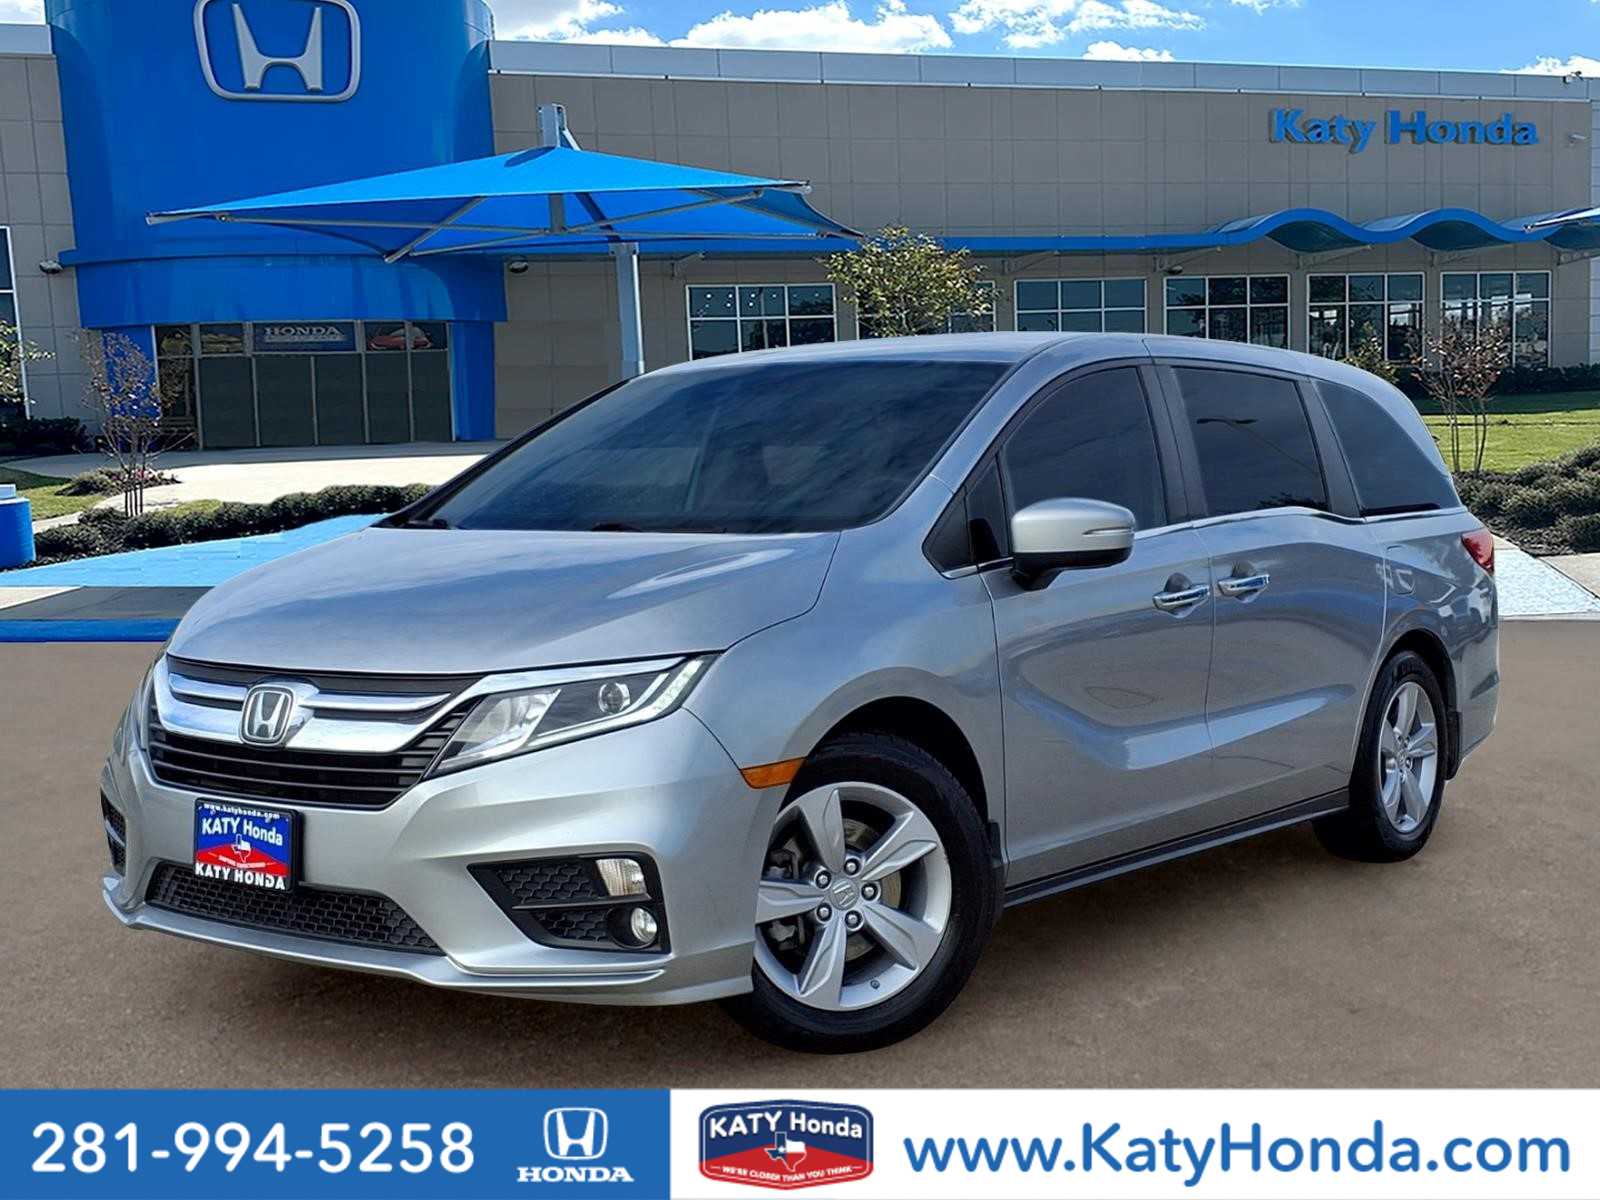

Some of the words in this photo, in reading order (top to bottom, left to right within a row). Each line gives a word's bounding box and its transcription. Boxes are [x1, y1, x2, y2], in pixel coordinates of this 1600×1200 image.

[1269, 108, 1376, 154] Katy
[1385, 110, 1539, 145] Honda
[264, 326, 345, 336] HONDA
[201, 816, 240, 835] KATY
[243, 819, 283, 846] Honda
[195, 862, 230, 880] KATY
[234, 869, 285, 890] HONDA
